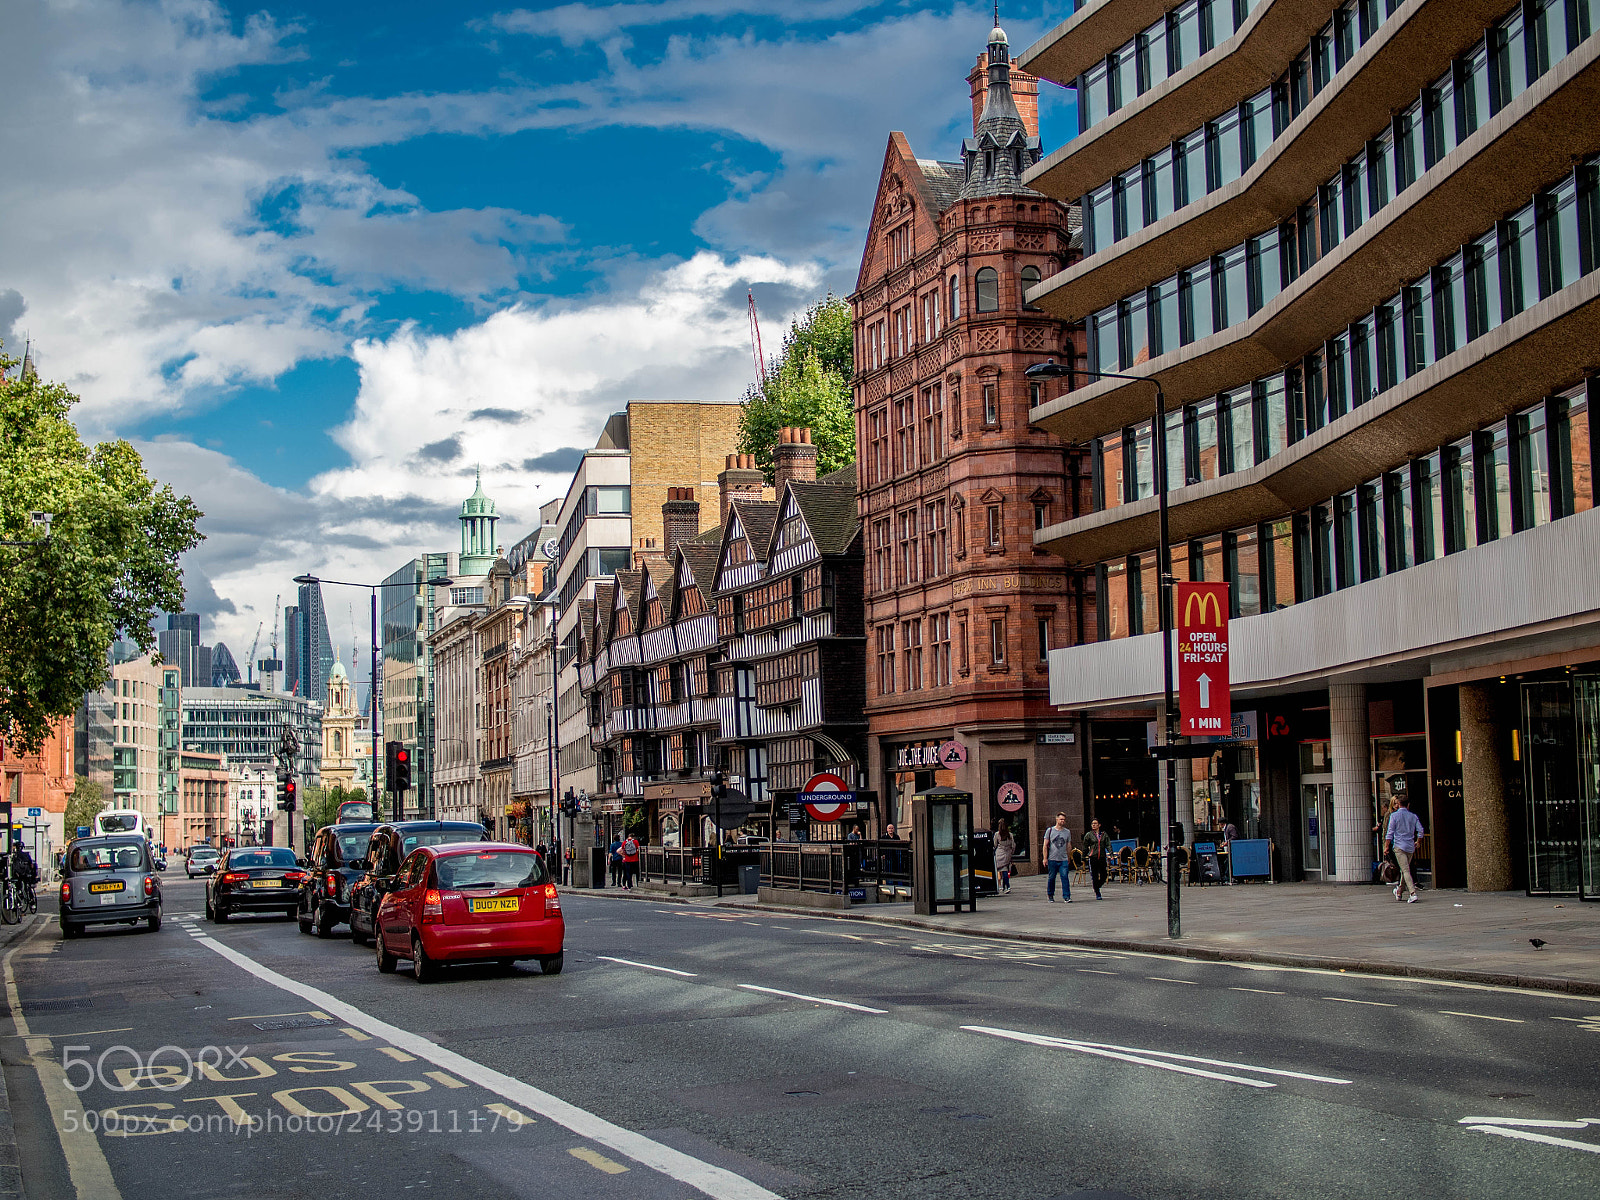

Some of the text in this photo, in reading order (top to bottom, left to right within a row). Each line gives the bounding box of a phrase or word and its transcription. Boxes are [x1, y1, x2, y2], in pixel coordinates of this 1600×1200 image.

[977, 577, 997, 590] INN
[1004, 576, 1062, 589] BUILDINGS
[1189, 632, 1217, 642] OPEN
[1179, 642, 1228, 653] 24 HOURS
[1183, 653, 1223, 663] FRI-SAT
[1189, 717, 1196, 729] 1
[1198, 717, 1222, 729] MIN
[897, 748, 908, 767] JOE
[911, 747, 922, 765] THE
[922, 745, 939, 765] JUICE
[476, 900, 517, 910] DU07 NZR
[113, 1051, 358, 1092] BUS
[103, 1079, 432, 1137] STOP
